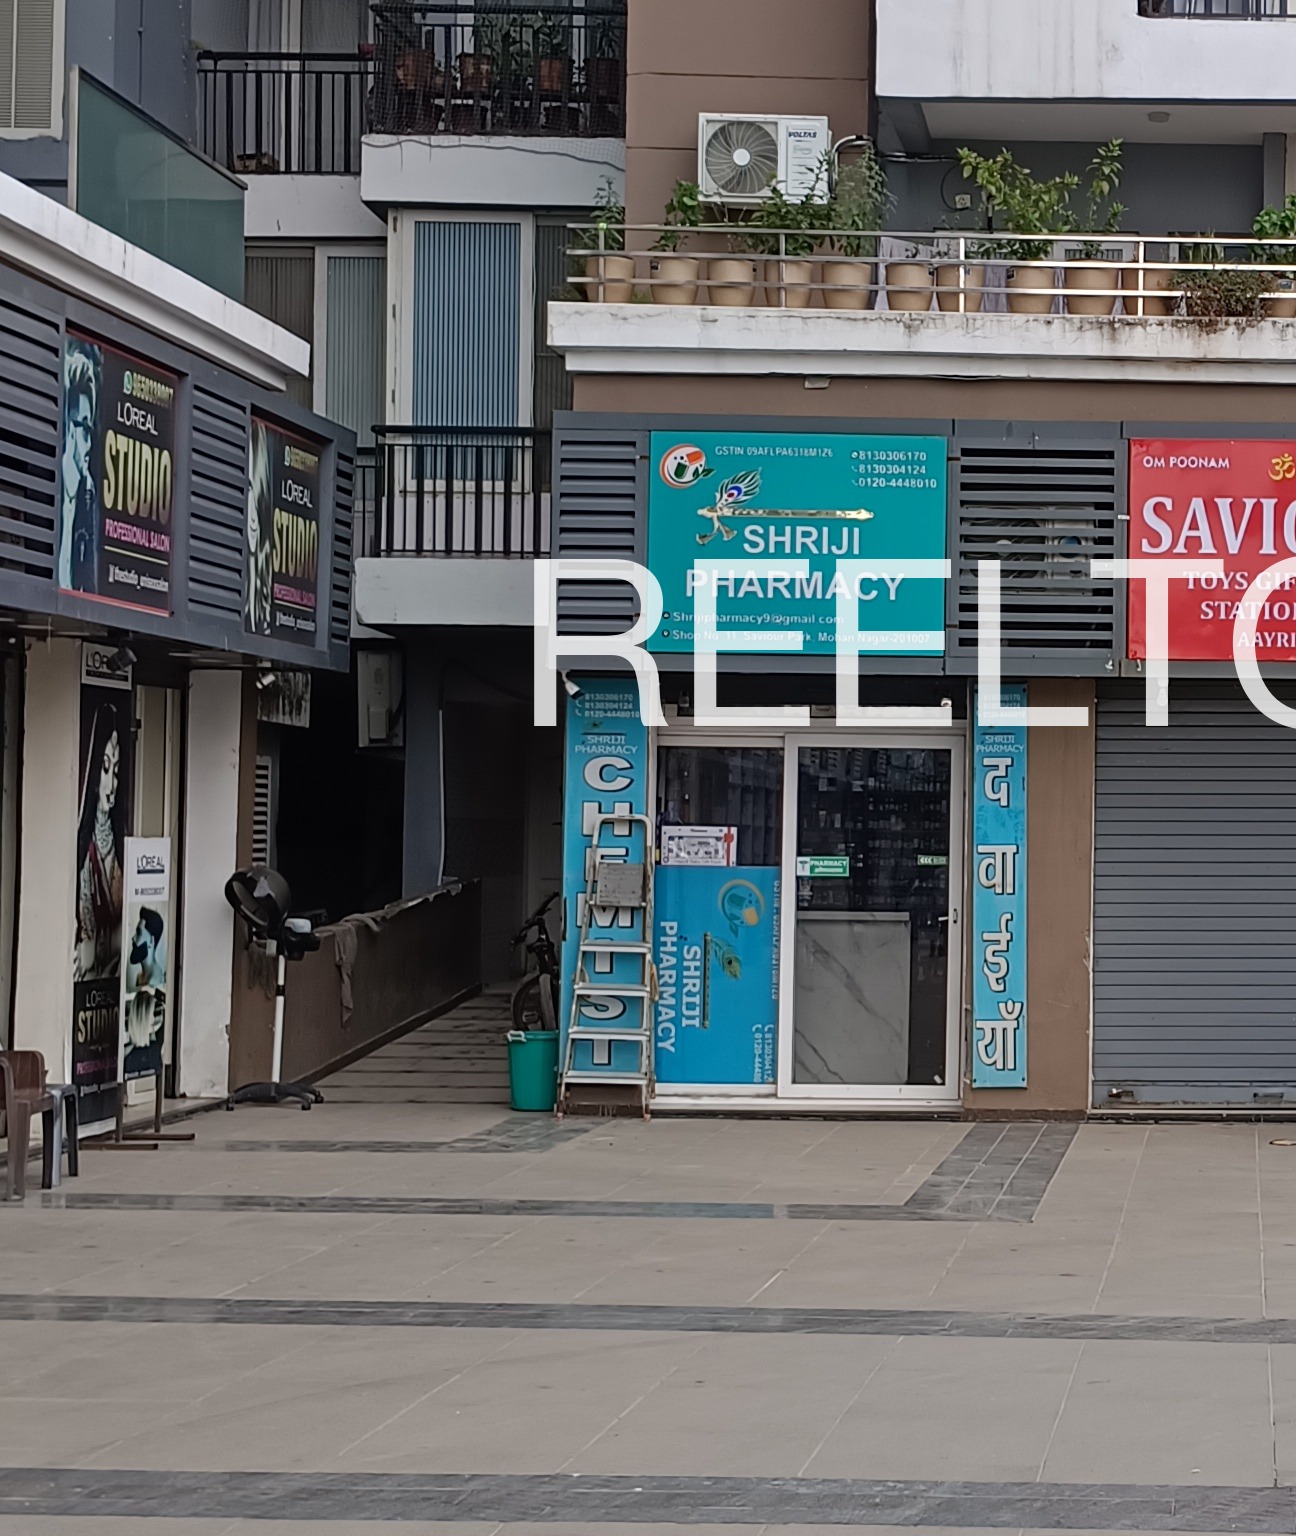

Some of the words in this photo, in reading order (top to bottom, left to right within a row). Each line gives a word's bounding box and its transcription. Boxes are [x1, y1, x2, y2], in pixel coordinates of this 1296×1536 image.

[788, 131, 817, 139] VOLTAS
[117, 401, 158, 436] LOREAL
[715, 445, 744, 456] GSTIN
[859, 450, 927, 462] 8130306170
[859, 465, 927, 475] 8130304124
[1143, 455, 1166, 469] OM
[1169, 455, 1230, 469] POONAM
[104, 429, 172, 526] STUDIO
[858, 478, 937, 489] 0120-4448010
[281, 479, 313, 508] LOREAL
[105, 517, 149, 548] PROFESSIONAL
[150, 531, 171, 552] SALON
[743, 524, 860, 555] SHRIJI
[273, 507, 318, 583] STUDIO
[685, 568, 905, 601] PHARMACY
[1183, 570, 1249, 590] TOYS
[587, 735, 626, 744] SHRIJI
[985, 734, 1015, 744] SHRIJI
[575, 745, 639, 755] PHARMACY
[976, 745, 1025, 753] PHARMACY
[657, 921, 678, 1054] PHARMACY
[681, 945, 701, 1028] SHRIJI
